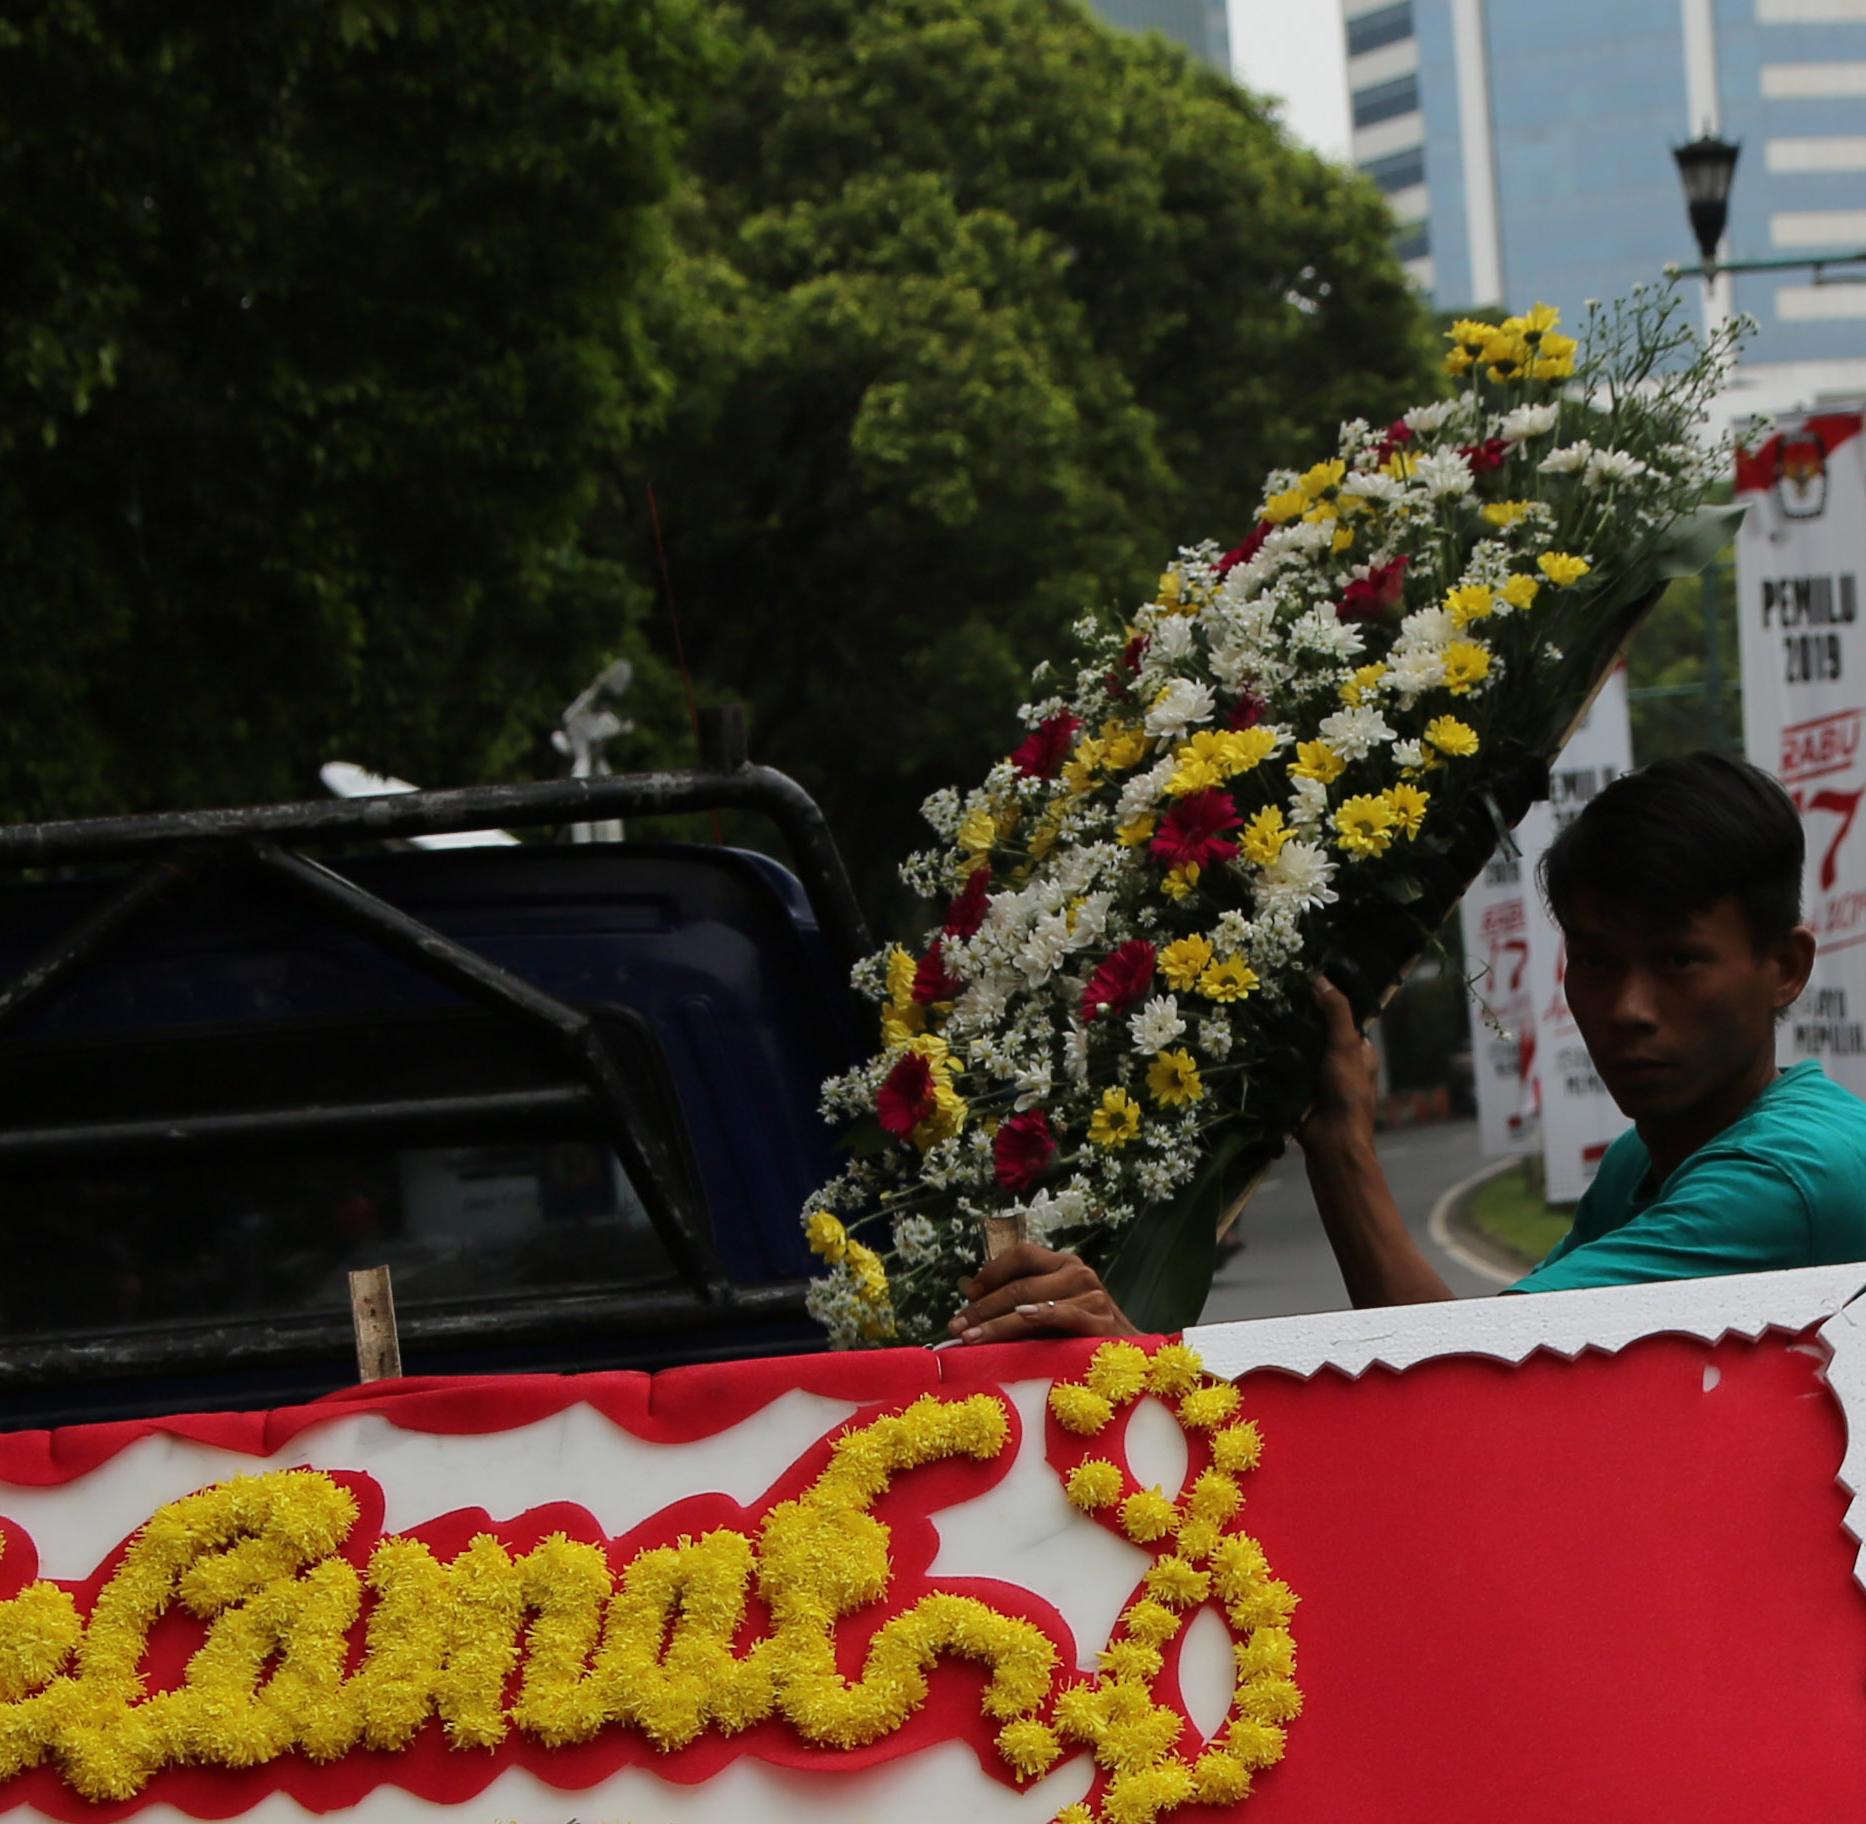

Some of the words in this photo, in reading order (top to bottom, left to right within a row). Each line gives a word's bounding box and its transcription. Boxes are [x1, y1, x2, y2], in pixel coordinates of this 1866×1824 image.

[1763, 576, 1855, 628] PEMILU
[1784, 635, 1841, 682] 2019
[1781, 720, 1862, 772] RABU
